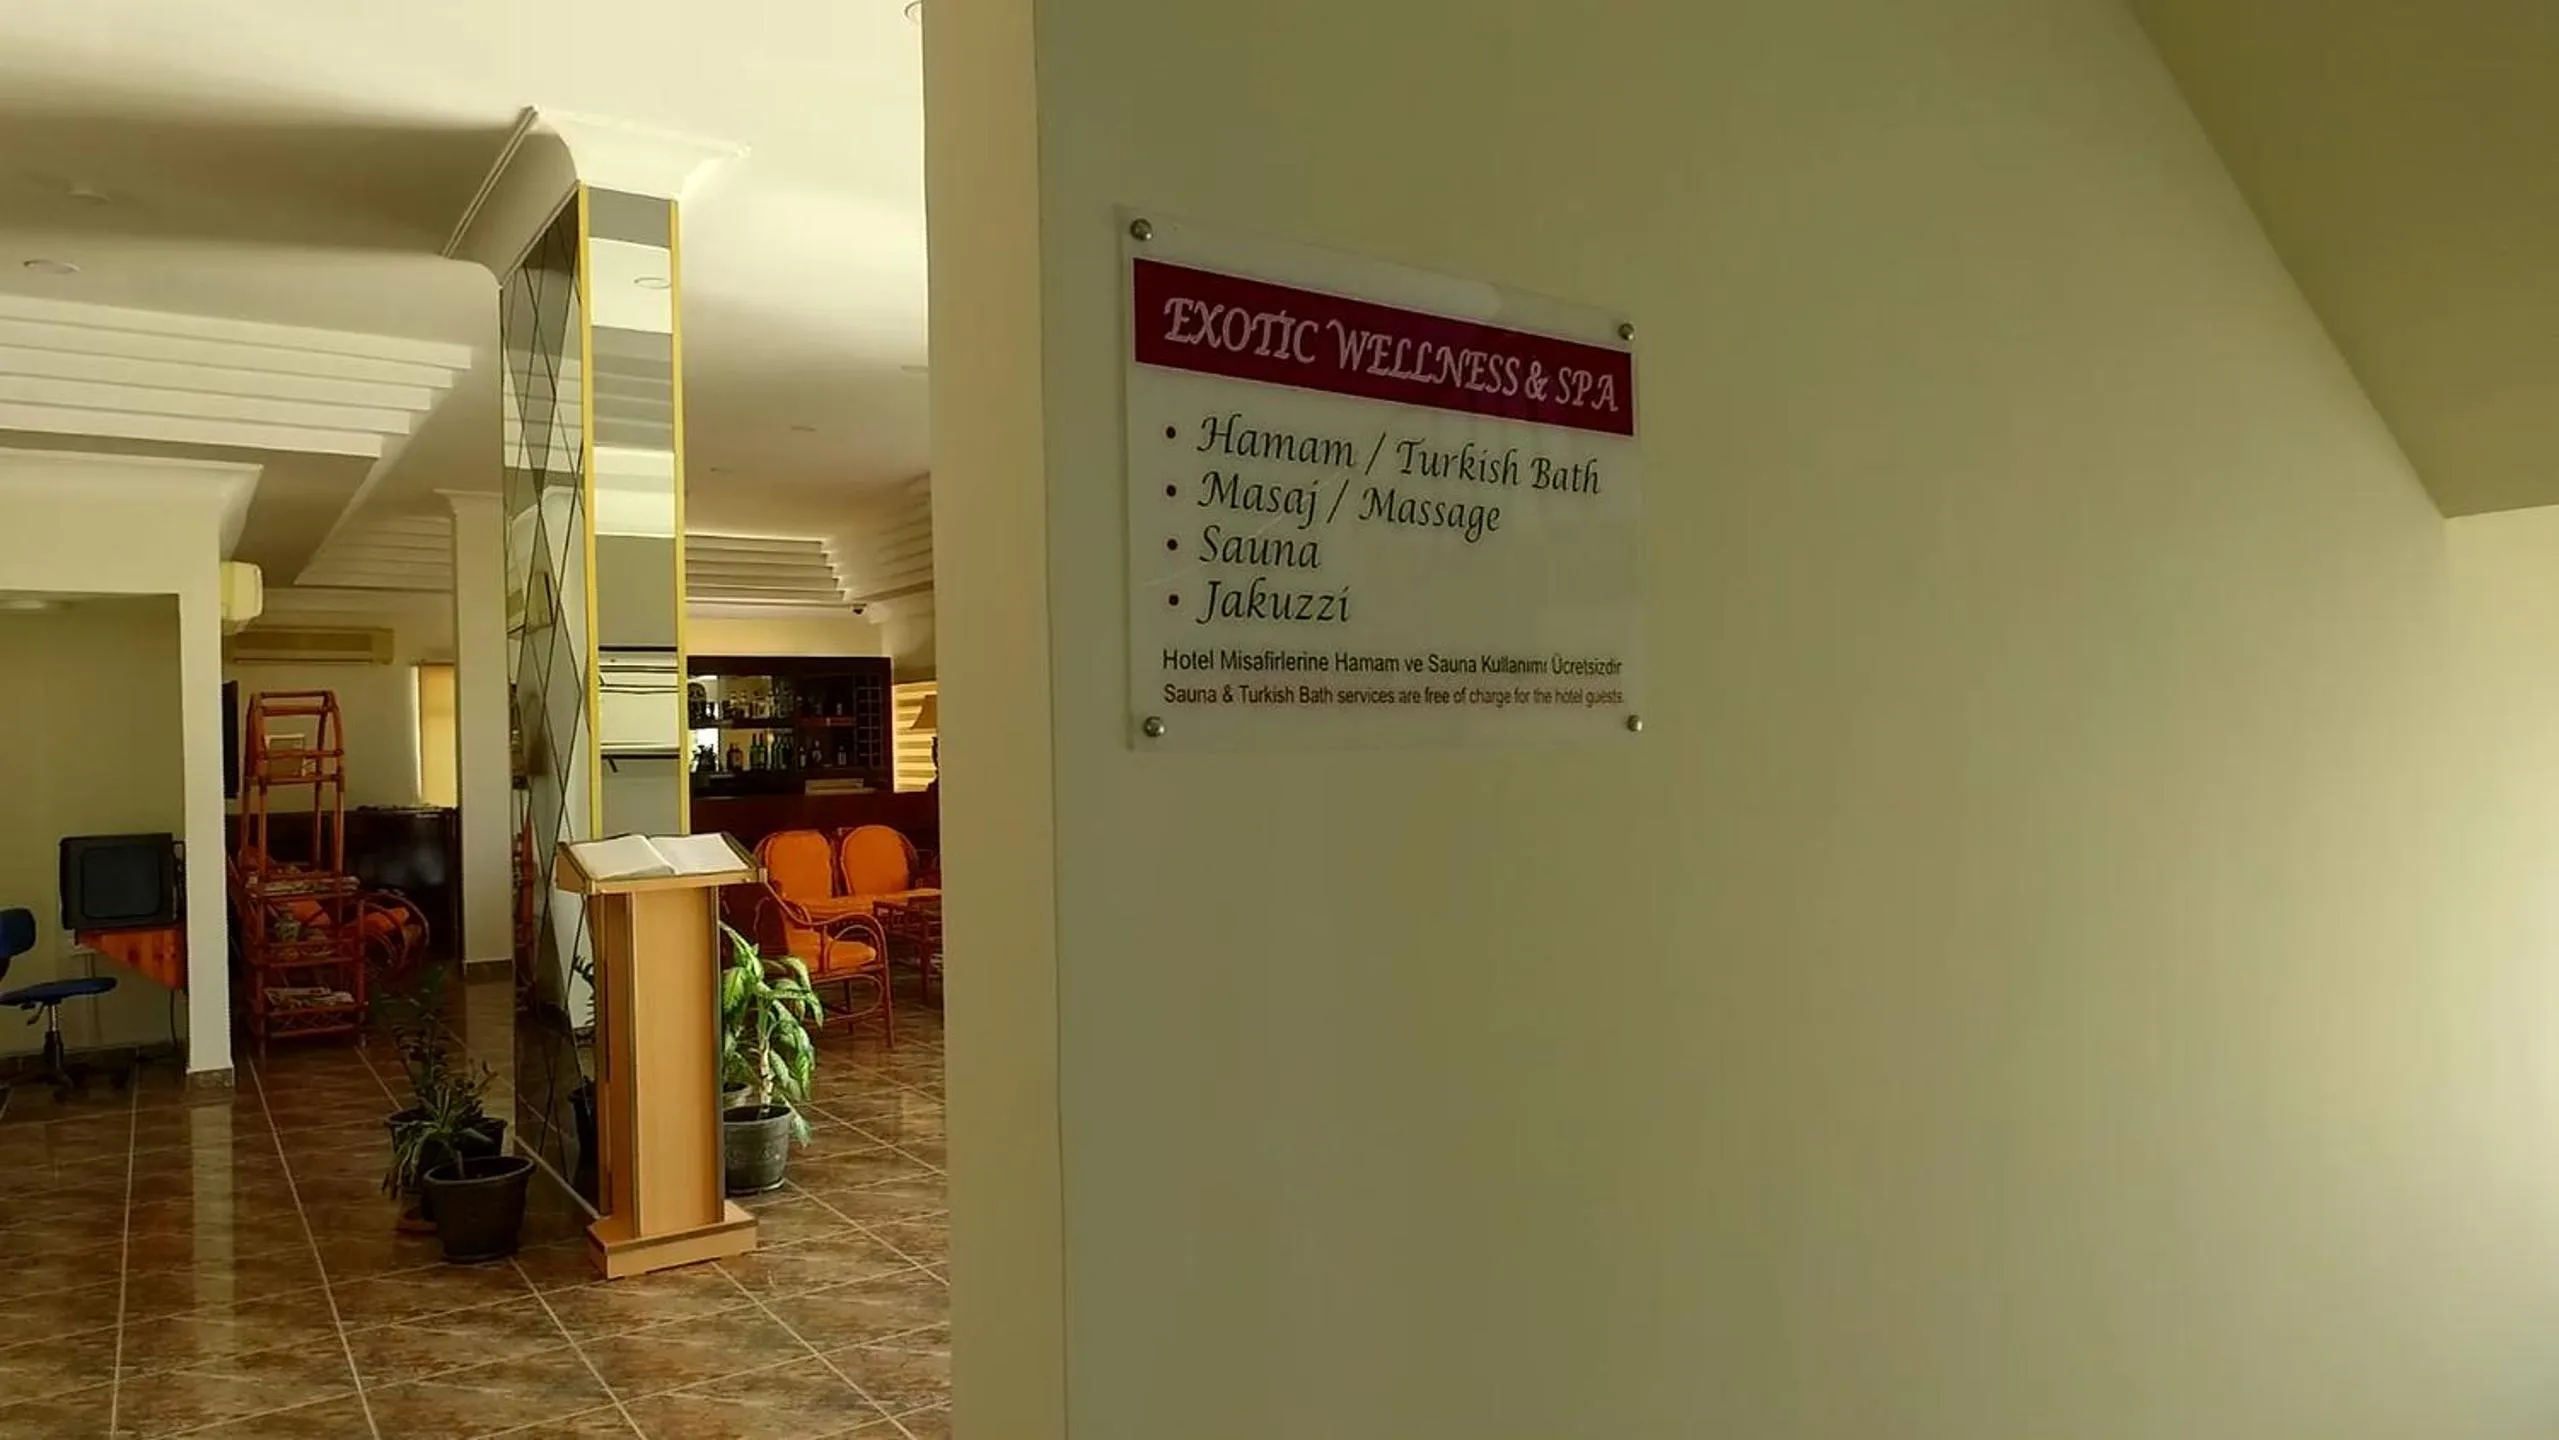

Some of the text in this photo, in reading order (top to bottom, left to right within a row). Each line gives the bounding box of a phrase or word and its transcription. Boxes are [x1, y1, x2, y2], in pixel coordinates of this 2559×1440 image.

[1326, 319, 1519, 396] WELLNESS
[1524, 361, 1549, 401] &
[1556, 367, 1620, 412] SPA
[1196, 413, 1601, 494] Hamam / Turkish Bath
[1197, 471, 1501, 543] Masaj / Massage
[1199, 525, 1321, 569] Sauna
[1196, 576, 1351, 624] Jakuzzi
[1163, 649, 1214, 670] Hotel
[1220, 649, 1329, 672] Misafirlerine
[1335, 652, 1400, 673] Hamam
[1404, 658, 1423, 673] ve
[1428, 653, 1477, 674] Sauna
[1164, 684, 1217, 704] Sauna
[1222, 684, 1233, 704] &
[1239, 685, 1294, 704] Turkish
[1300, 686, 1333, 704] Bath
[1337, 688, 1395, 704] services
[1399, 690, 1421, 704] are
[1424, 687, 1450, 704] free
[1453, 687, 1467, 704] of
[1469, 688, 1512, 708] charge
[1514, 688, 1531, 704] for
[1533, 688, 1552, 704] the
[1555, 688, 1583, 704] hotel
